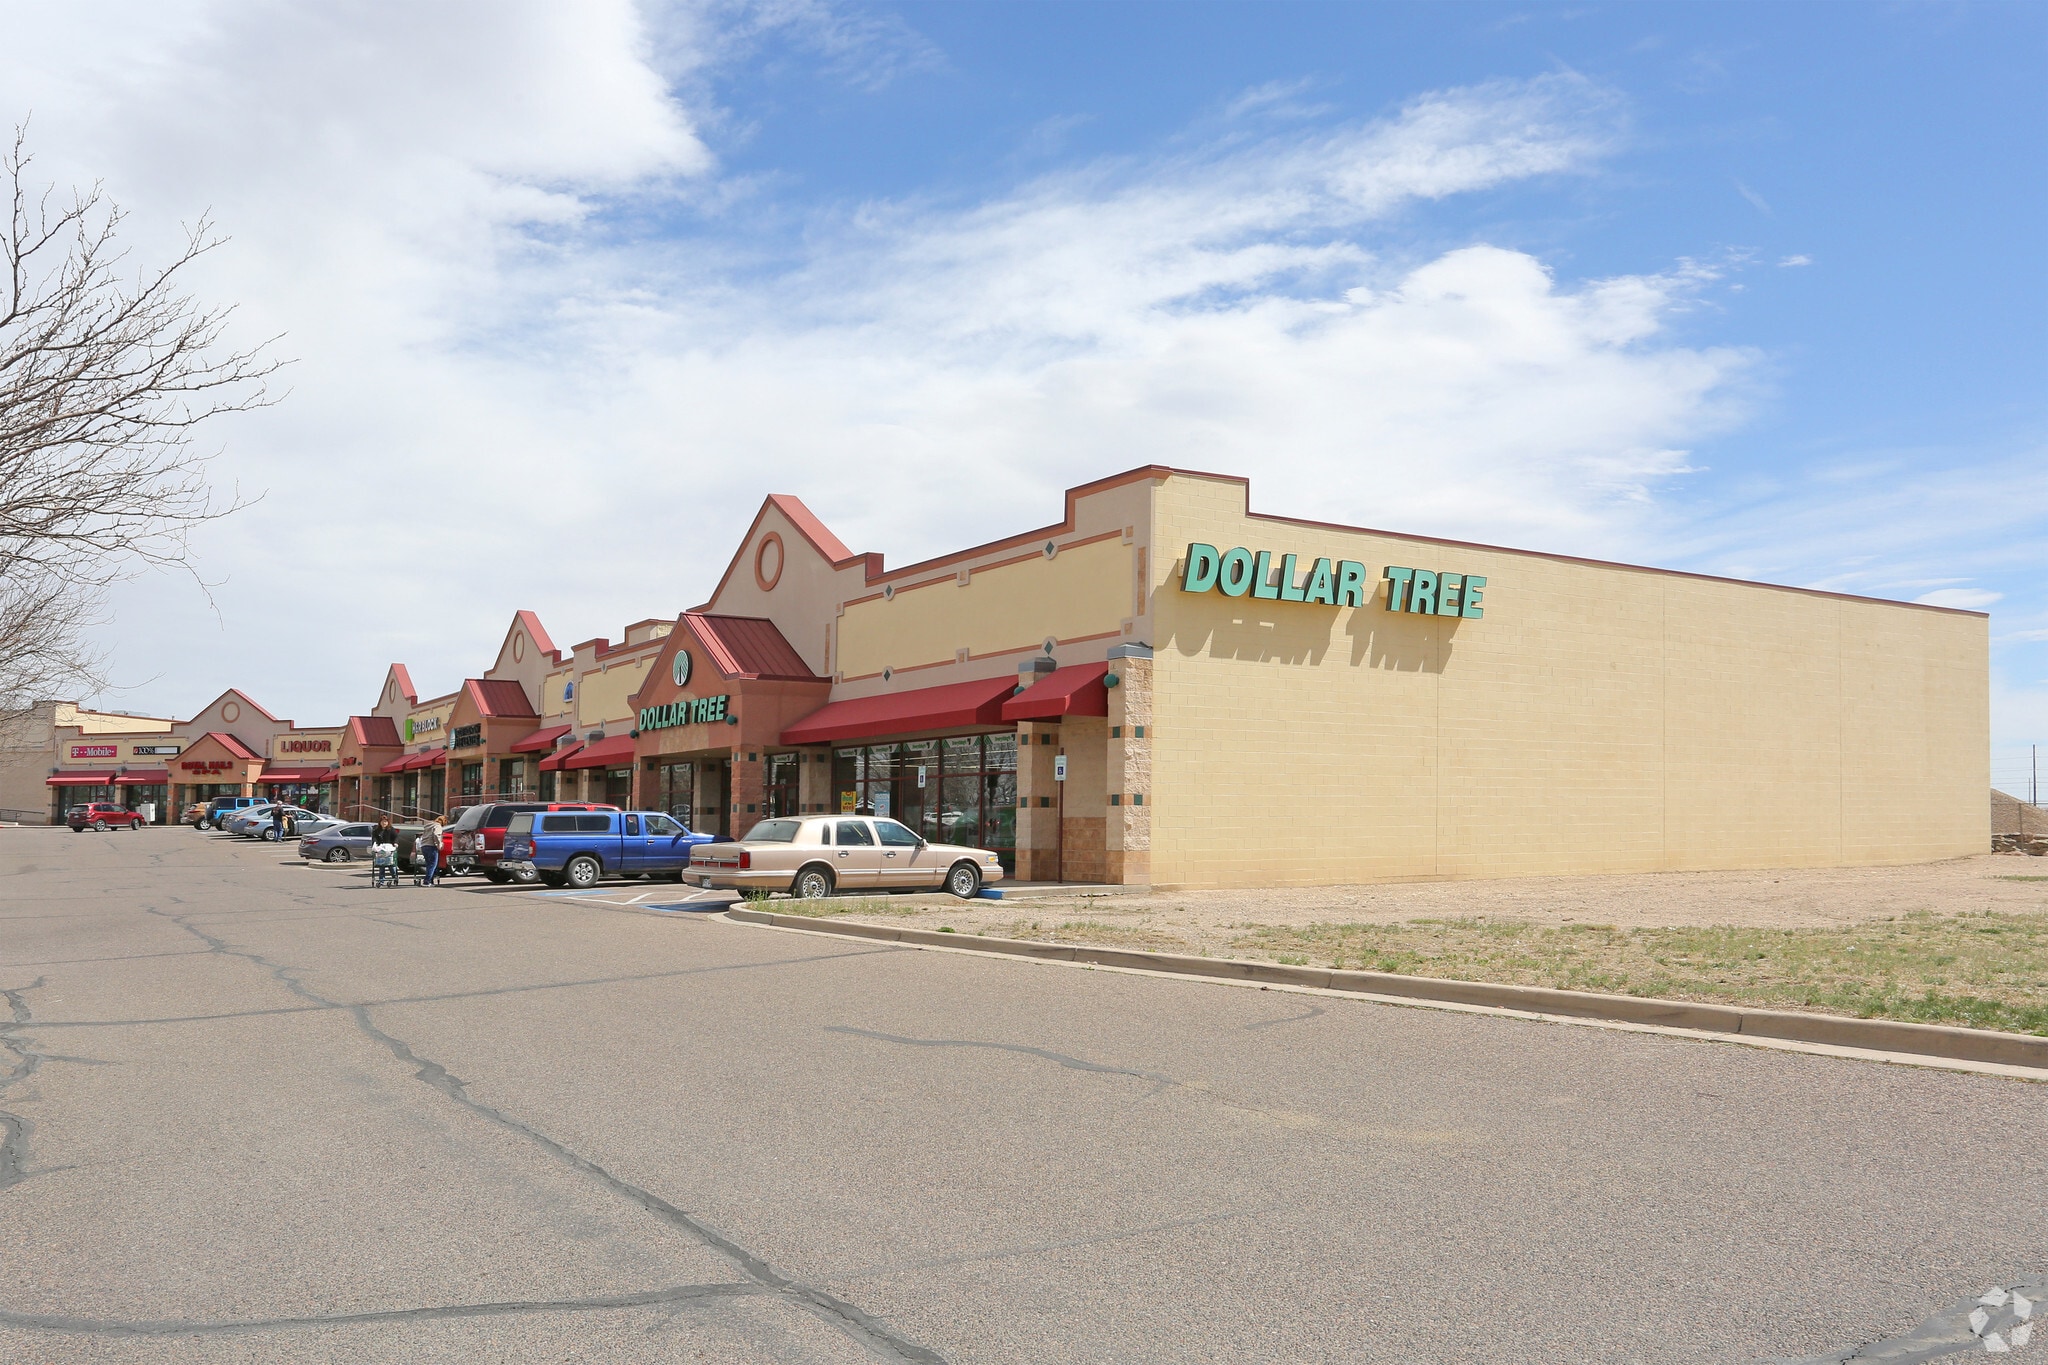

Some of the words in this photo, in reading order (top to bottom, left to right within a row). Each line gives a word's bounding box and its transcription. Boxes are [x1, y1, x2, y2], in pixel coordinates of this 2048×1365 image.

[1181, 542, 1366, 608] DOLLAR
[1383, 565, 1487, 619] TREE
[639, 701, 687, 731] DOLLAR
[691, 695, 726, 723] TREE
[280, 740, 332, 753] LIQUOR
